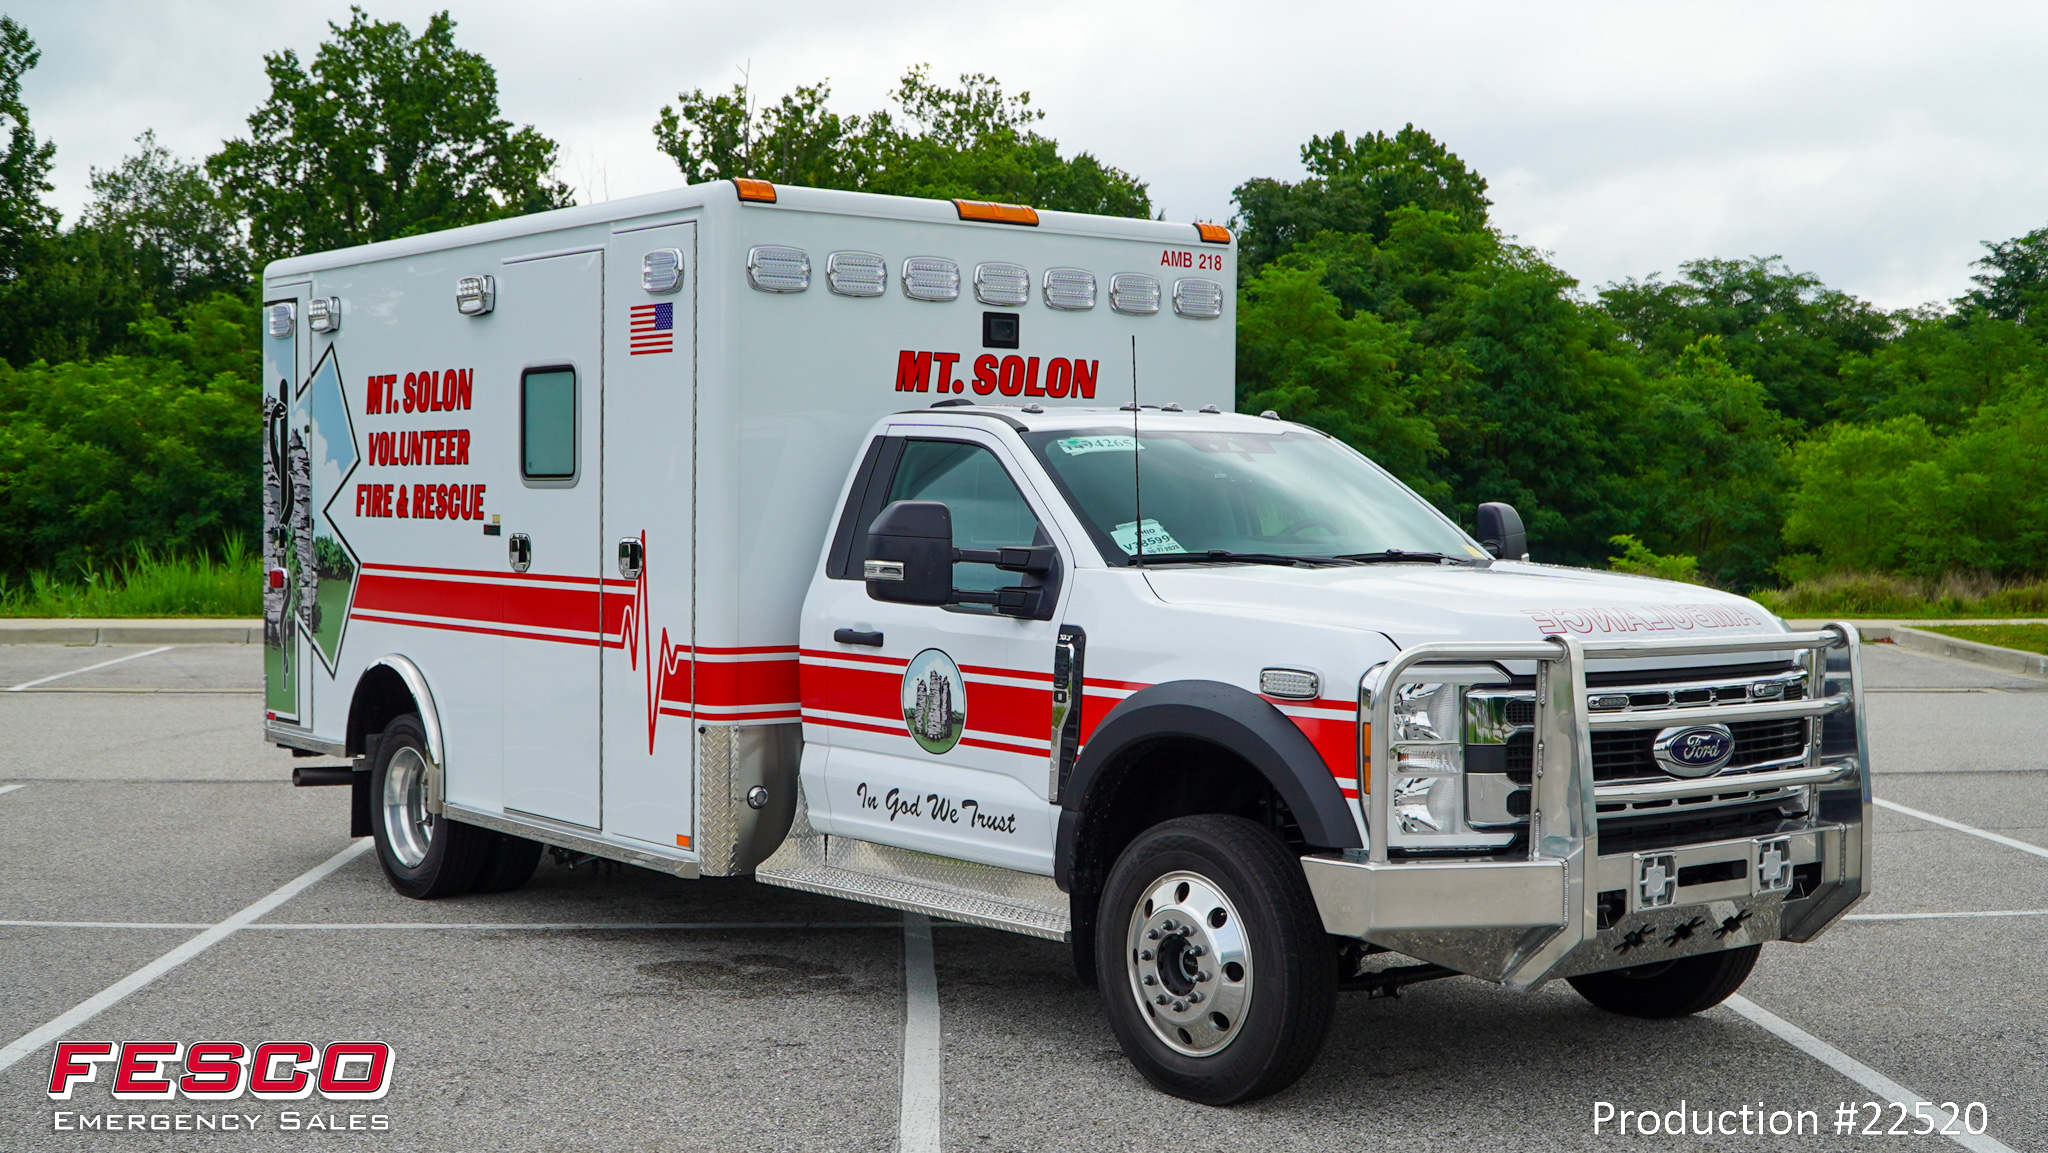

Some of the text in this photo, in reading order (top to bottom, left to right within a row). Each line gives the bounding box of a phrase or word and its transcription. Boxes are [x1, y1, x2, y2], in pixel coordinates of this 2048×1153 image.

[1160, 250, 1223, 271] AMB 218
[366, 368, 474, 415] MT. SOLON
[895, 350, 1099, 399] MT. SOLON
[368, 429, 470, 467] VOLUNTEER
[355, 484, 486, 520] FIRE & RESCUE
[1683, 734, 1721, 760] Ford
[856, 782, 1017, 834] In God We Trust
